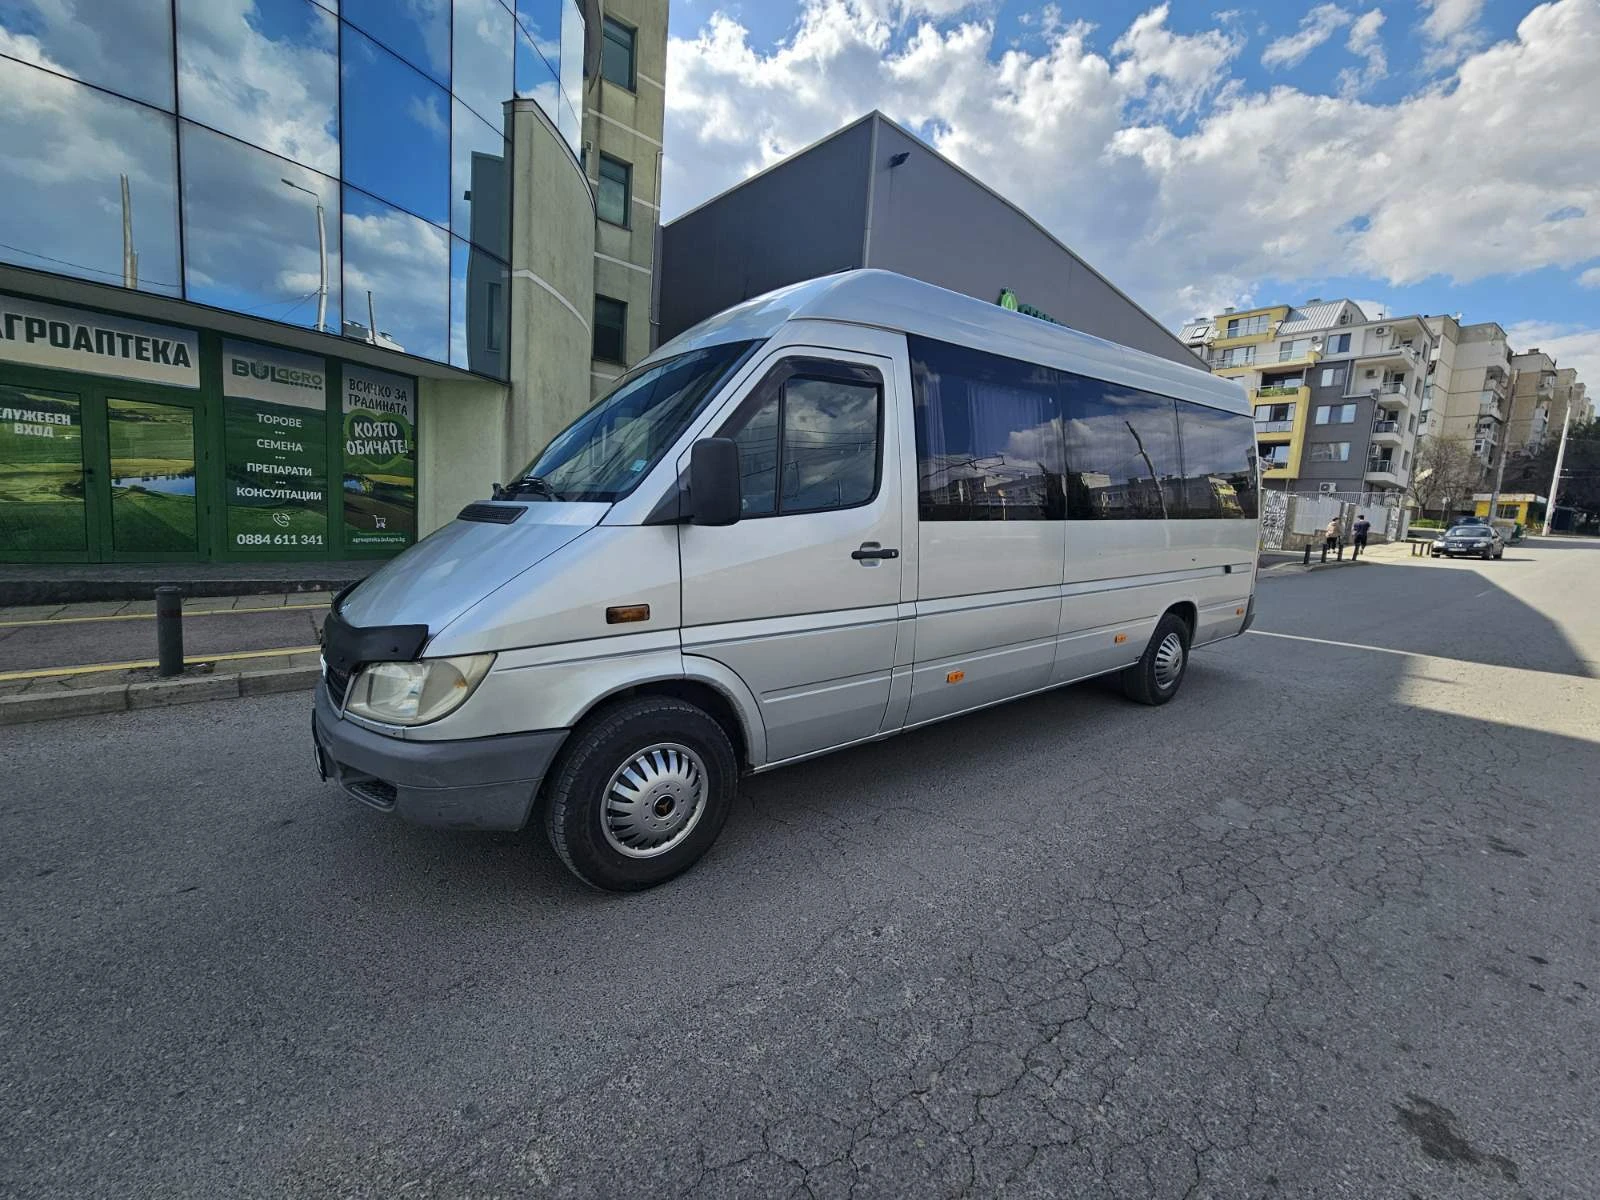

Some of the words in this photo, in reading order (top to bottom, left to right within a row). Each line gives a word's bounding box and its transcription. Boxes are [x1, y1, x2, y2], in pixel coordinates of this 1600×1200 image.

[0, 313, 191, 368] ГРОАПТЕКА
[348, 378, 392, 398] ВСИЧКО
[394, 388, 408, 402] ЗА
[348, 393, 408, 416] ГРАДИНАТА
[256, 413, 303, 428] ТОРОВЕ
[14, 422, 54, 438] ВХОД
[353, 421, 398, 438] КОЯТО
[256, 438, 304, 452] СЕМЕНА
[346, 439, 409, 456] ОБИЧАТЕ!
[246, 462, 313, 477] ПРЕПАРАТИ
[236, 486, 322, 502] КОНСУЛТАЦИИ
[236, 533, 271, 545] 0884
[274, 534, 298, 545] 611
[300, 534, 324, 545] 341
